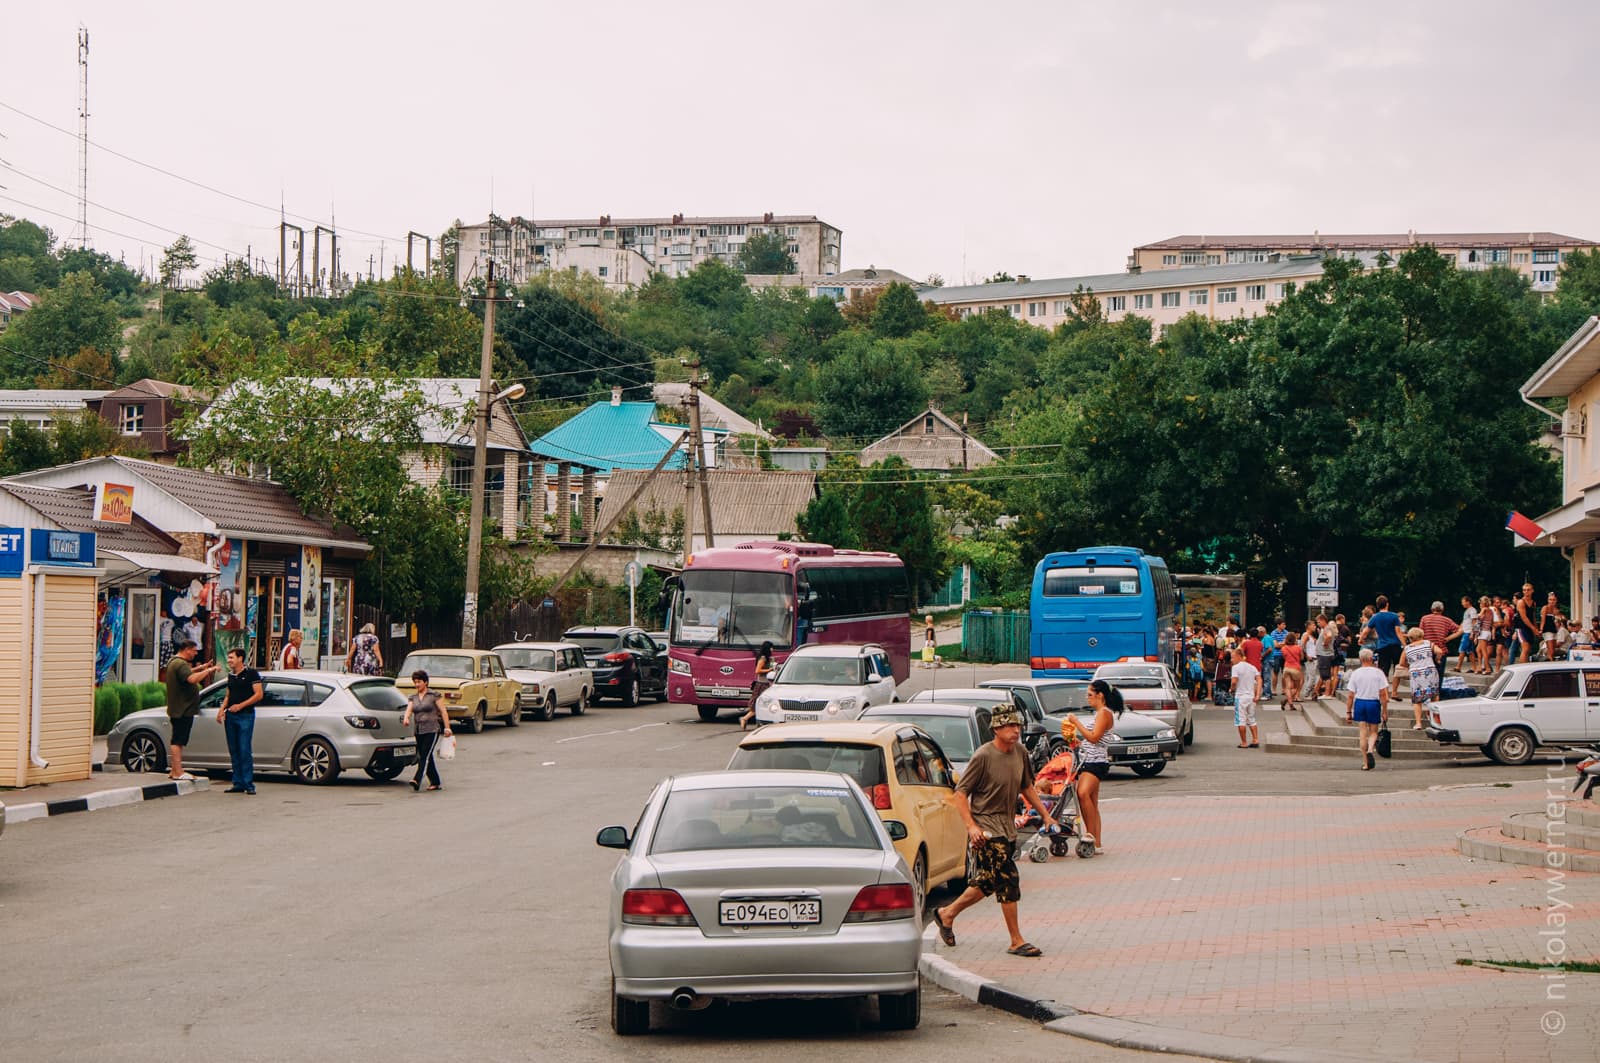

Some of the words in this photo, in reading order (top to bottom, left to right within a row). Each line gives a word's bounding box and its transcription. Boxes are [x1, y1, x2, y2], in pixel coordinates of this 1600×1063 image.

[102, 497, 131, 518] НАХОДКА
[727, 905, 788, 920] Е094ЕО
[792, 903, 816, 915] 123
